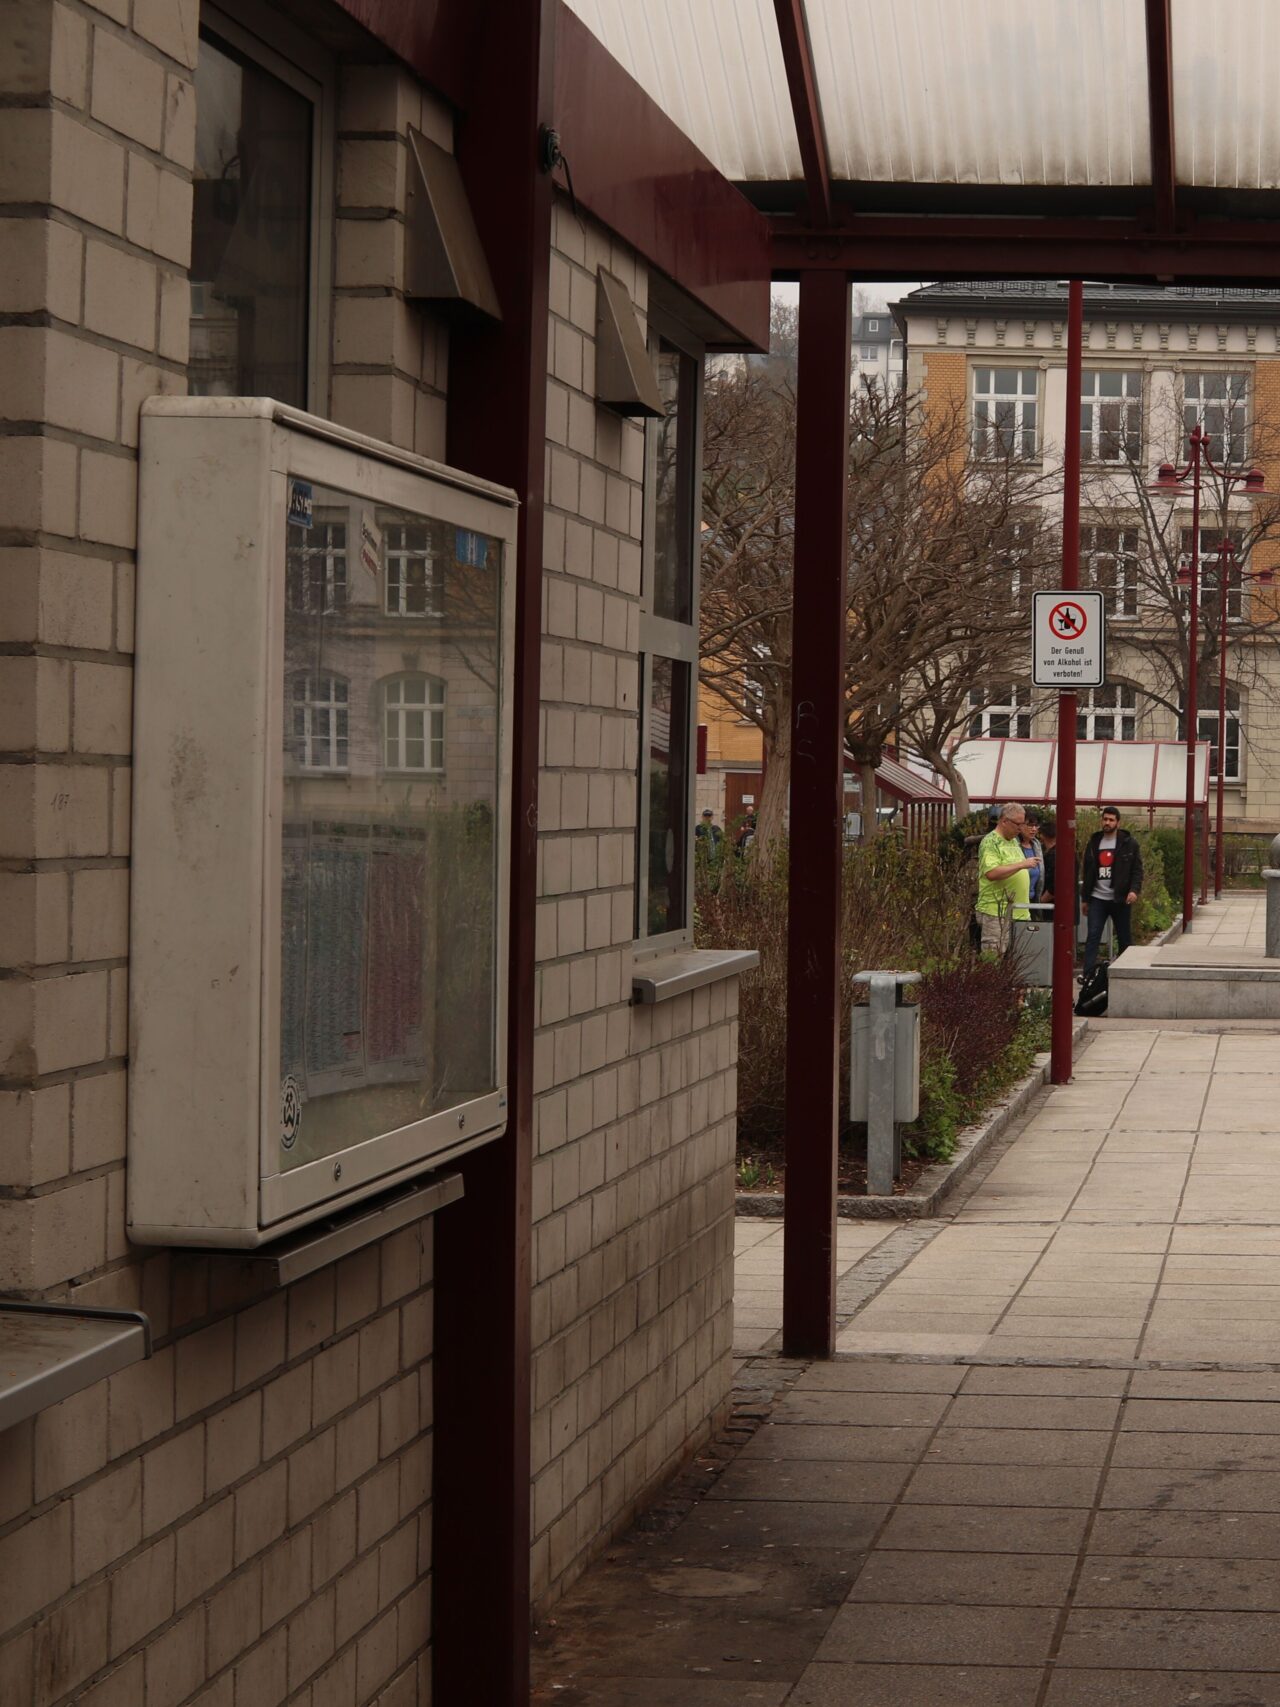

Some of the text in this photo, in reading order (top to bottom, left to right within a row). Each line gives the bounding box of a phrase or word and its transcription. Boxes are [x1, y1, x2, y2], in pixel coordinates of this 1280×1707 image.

[1051, 647, 1085, 655] Der Genuß
[1057, 658, 1082, 666] Alkohol
[1084, 658, 1092, 666] ist
[1053, 670, 1083, 678] verboten!
